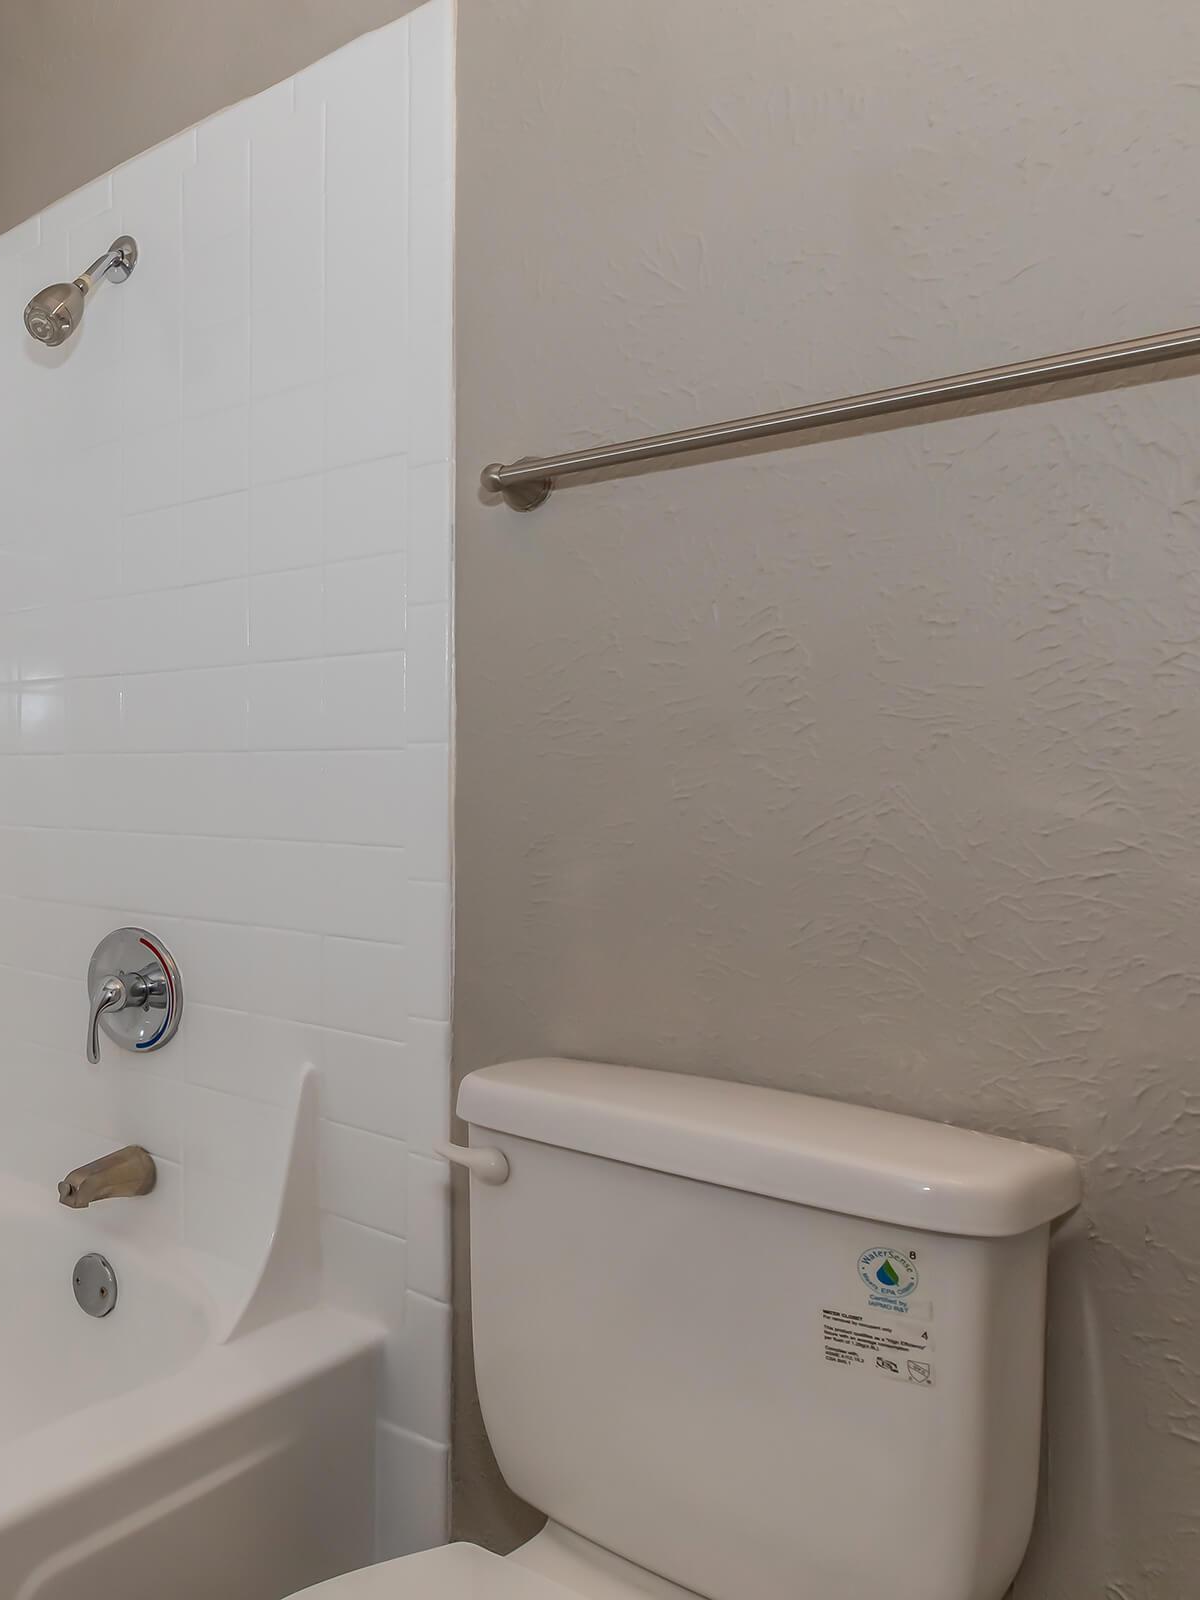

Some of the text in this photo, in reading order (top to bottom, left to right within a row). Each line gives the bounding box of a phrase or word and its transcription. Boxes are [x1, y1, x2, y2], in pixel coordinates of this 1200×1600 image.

[861, 1250, 913, 1273] WaterSense
[881, 1288, 896, 1296] EPA
[869, 1294, 898, 1305] Certified
